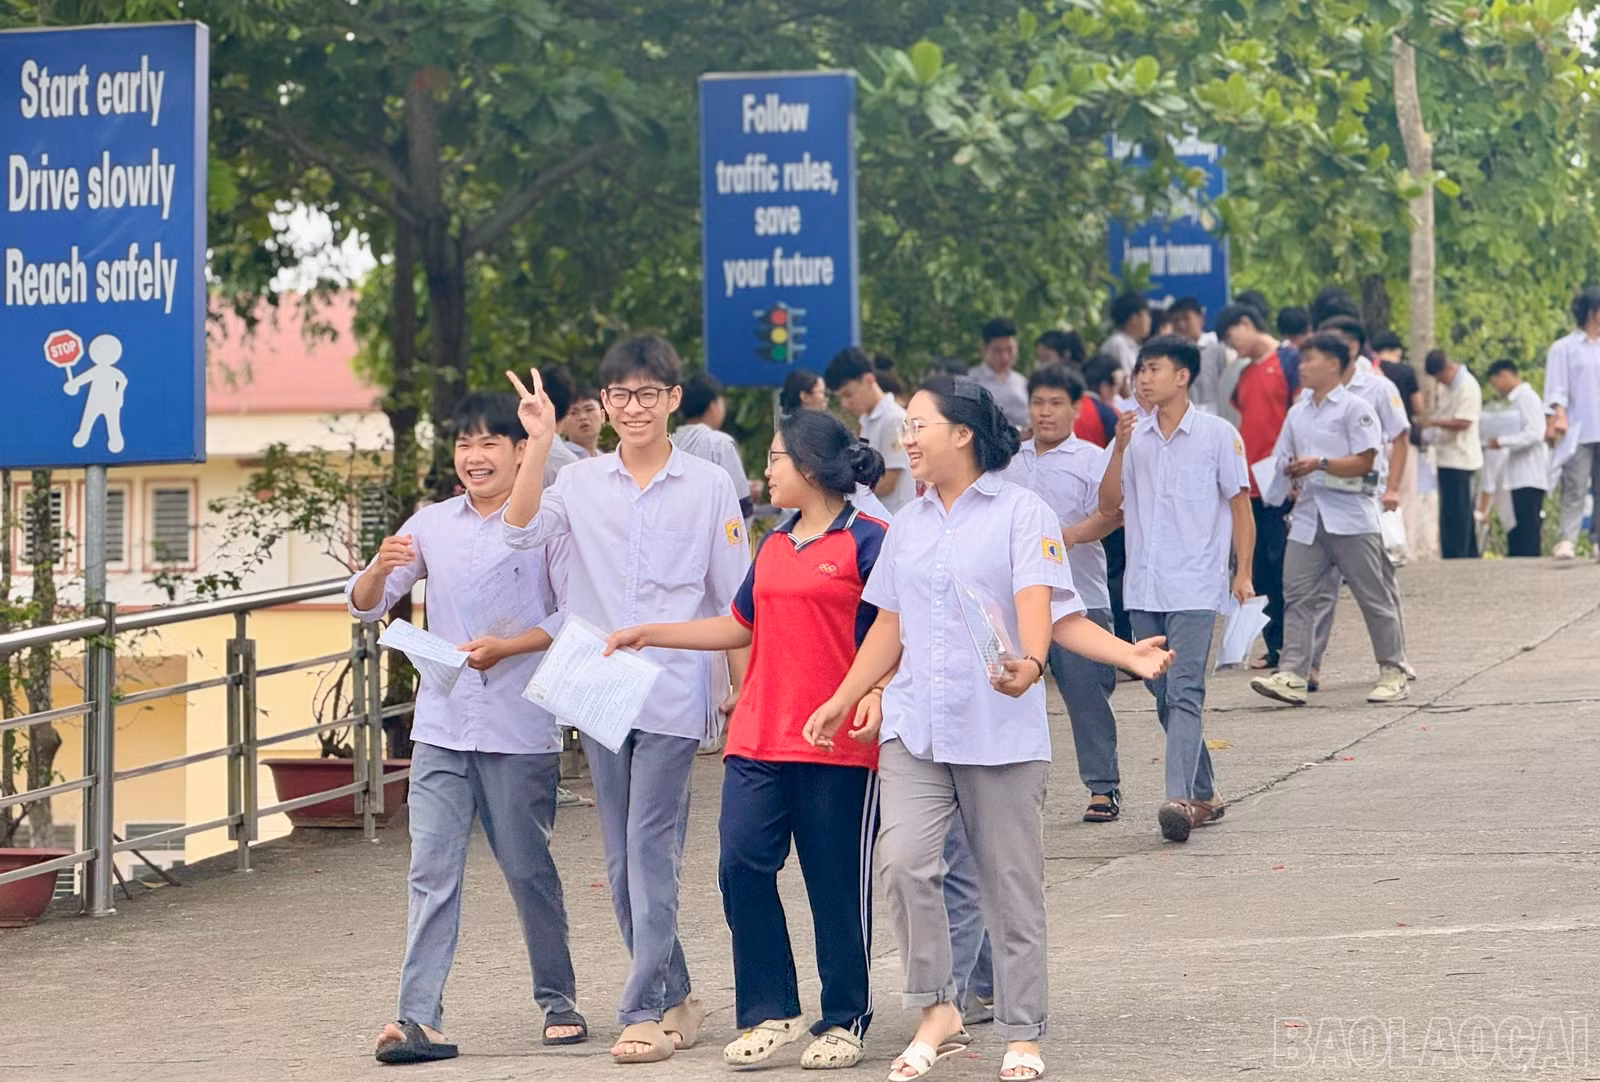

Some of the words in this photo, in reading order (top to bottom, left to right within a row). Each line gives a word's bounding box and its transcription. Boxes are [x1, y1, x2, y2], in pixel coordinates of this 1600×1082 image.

[21, 60, 89, 119] Start
[97, 55, 164, 126] early
[742, 94, 809, 133] Follow
[8, 154, 79, 212] Drive
[87, 148, 175, 219] slowly
[715, 154, 778, 194] traffic
[783, 153, 838, 194] rules,
[755, 205, 801, 235] save
[5, 246, 87, 305] Reach
[96, 242, 177, 313] safely
[723, 259, 769, 296] your
[772, 247, 834, 286] future
[50, 340, 76, 358] STOP
